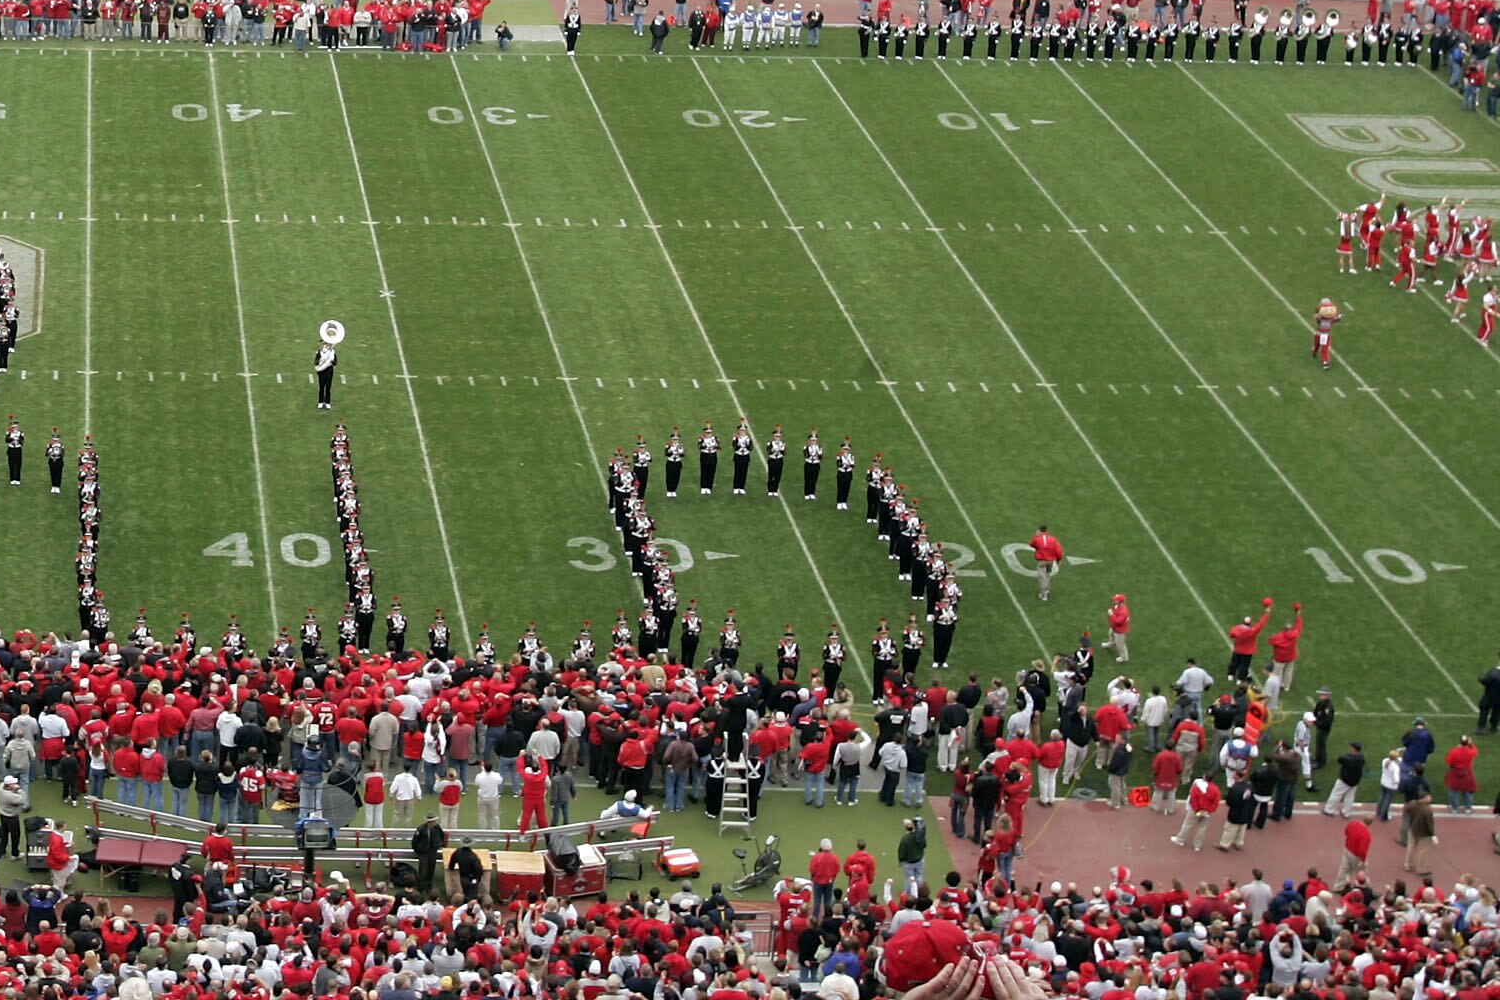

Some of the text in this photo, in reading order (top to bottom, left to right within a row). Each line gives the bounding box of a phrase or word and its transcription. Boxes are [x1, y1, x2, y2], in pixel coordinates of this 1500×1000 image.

[202, 531, 333, 568] 40
[1303, 546, 1428, 585] 10
[318, 711, 334, 725] 72
[240, 776, 258, 793] 45
